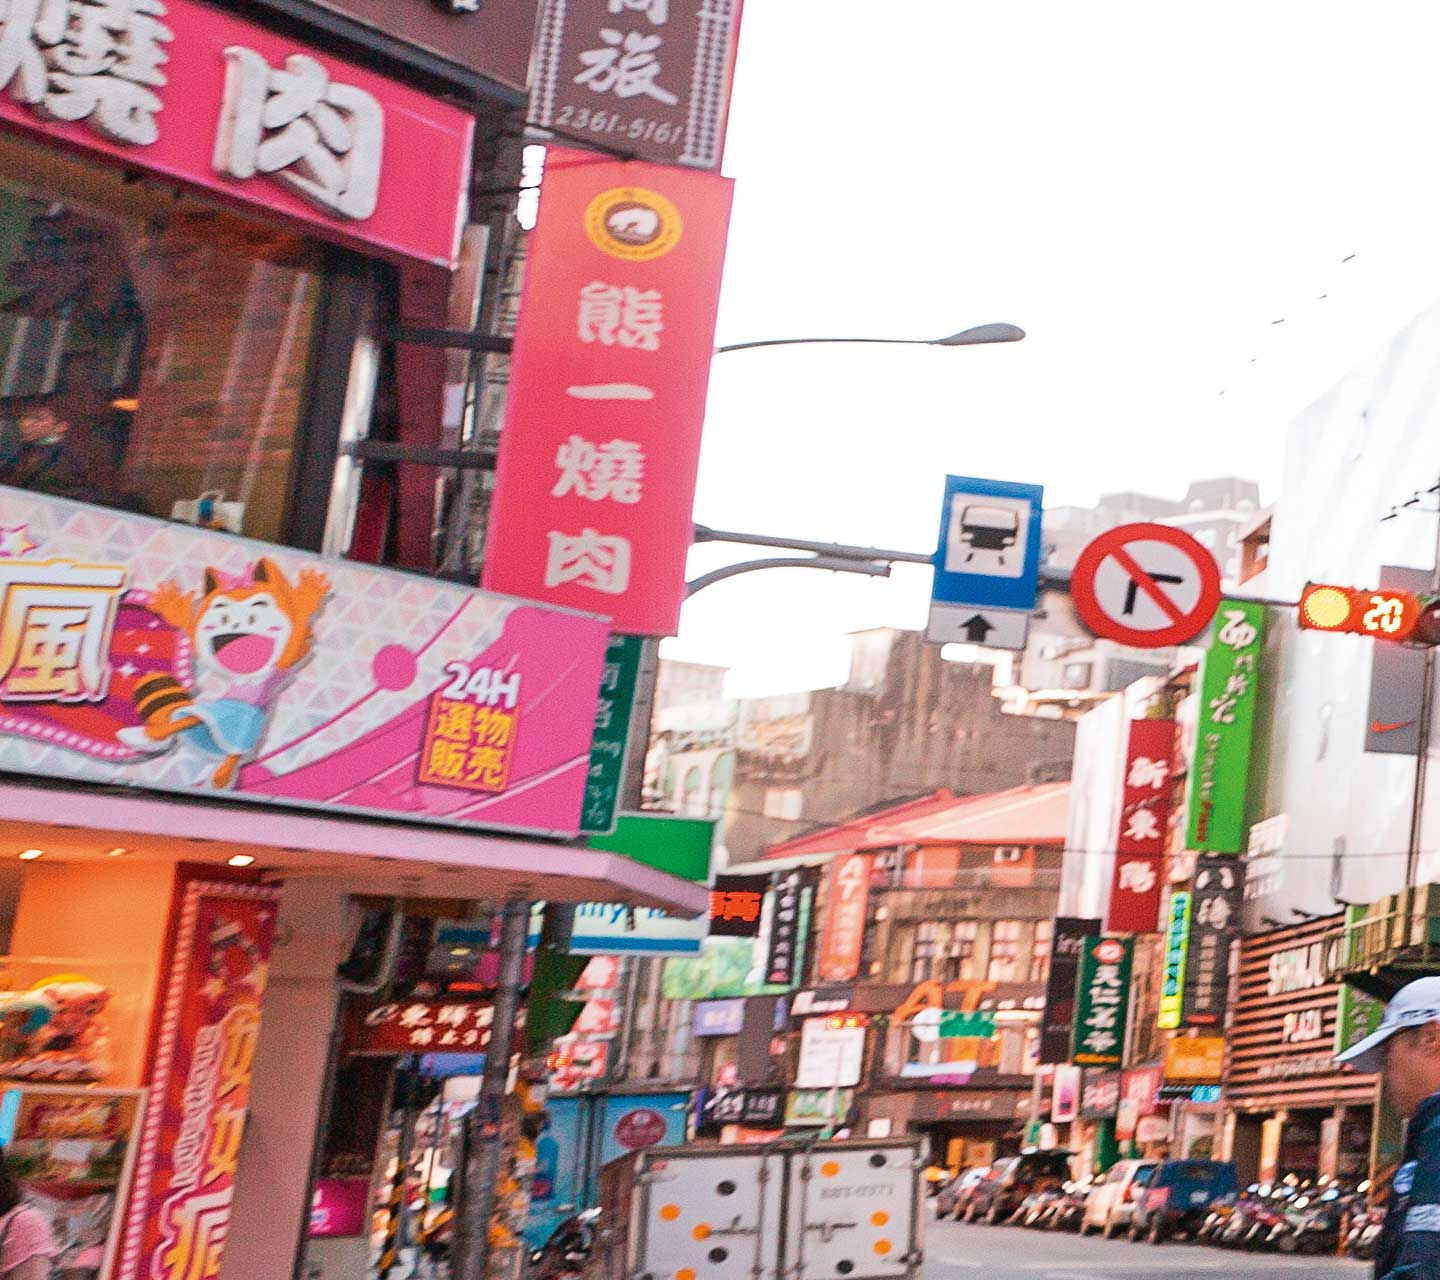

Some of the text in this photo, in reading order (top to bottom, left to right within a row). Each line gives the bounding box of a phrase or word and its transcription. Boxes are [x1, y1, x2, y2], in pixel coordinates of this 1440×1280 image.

[544, 279, 666, 595] 熊一燒肉
[1361, 595, 1404, 633] 20
[441, 659, 521, 710] 24H
